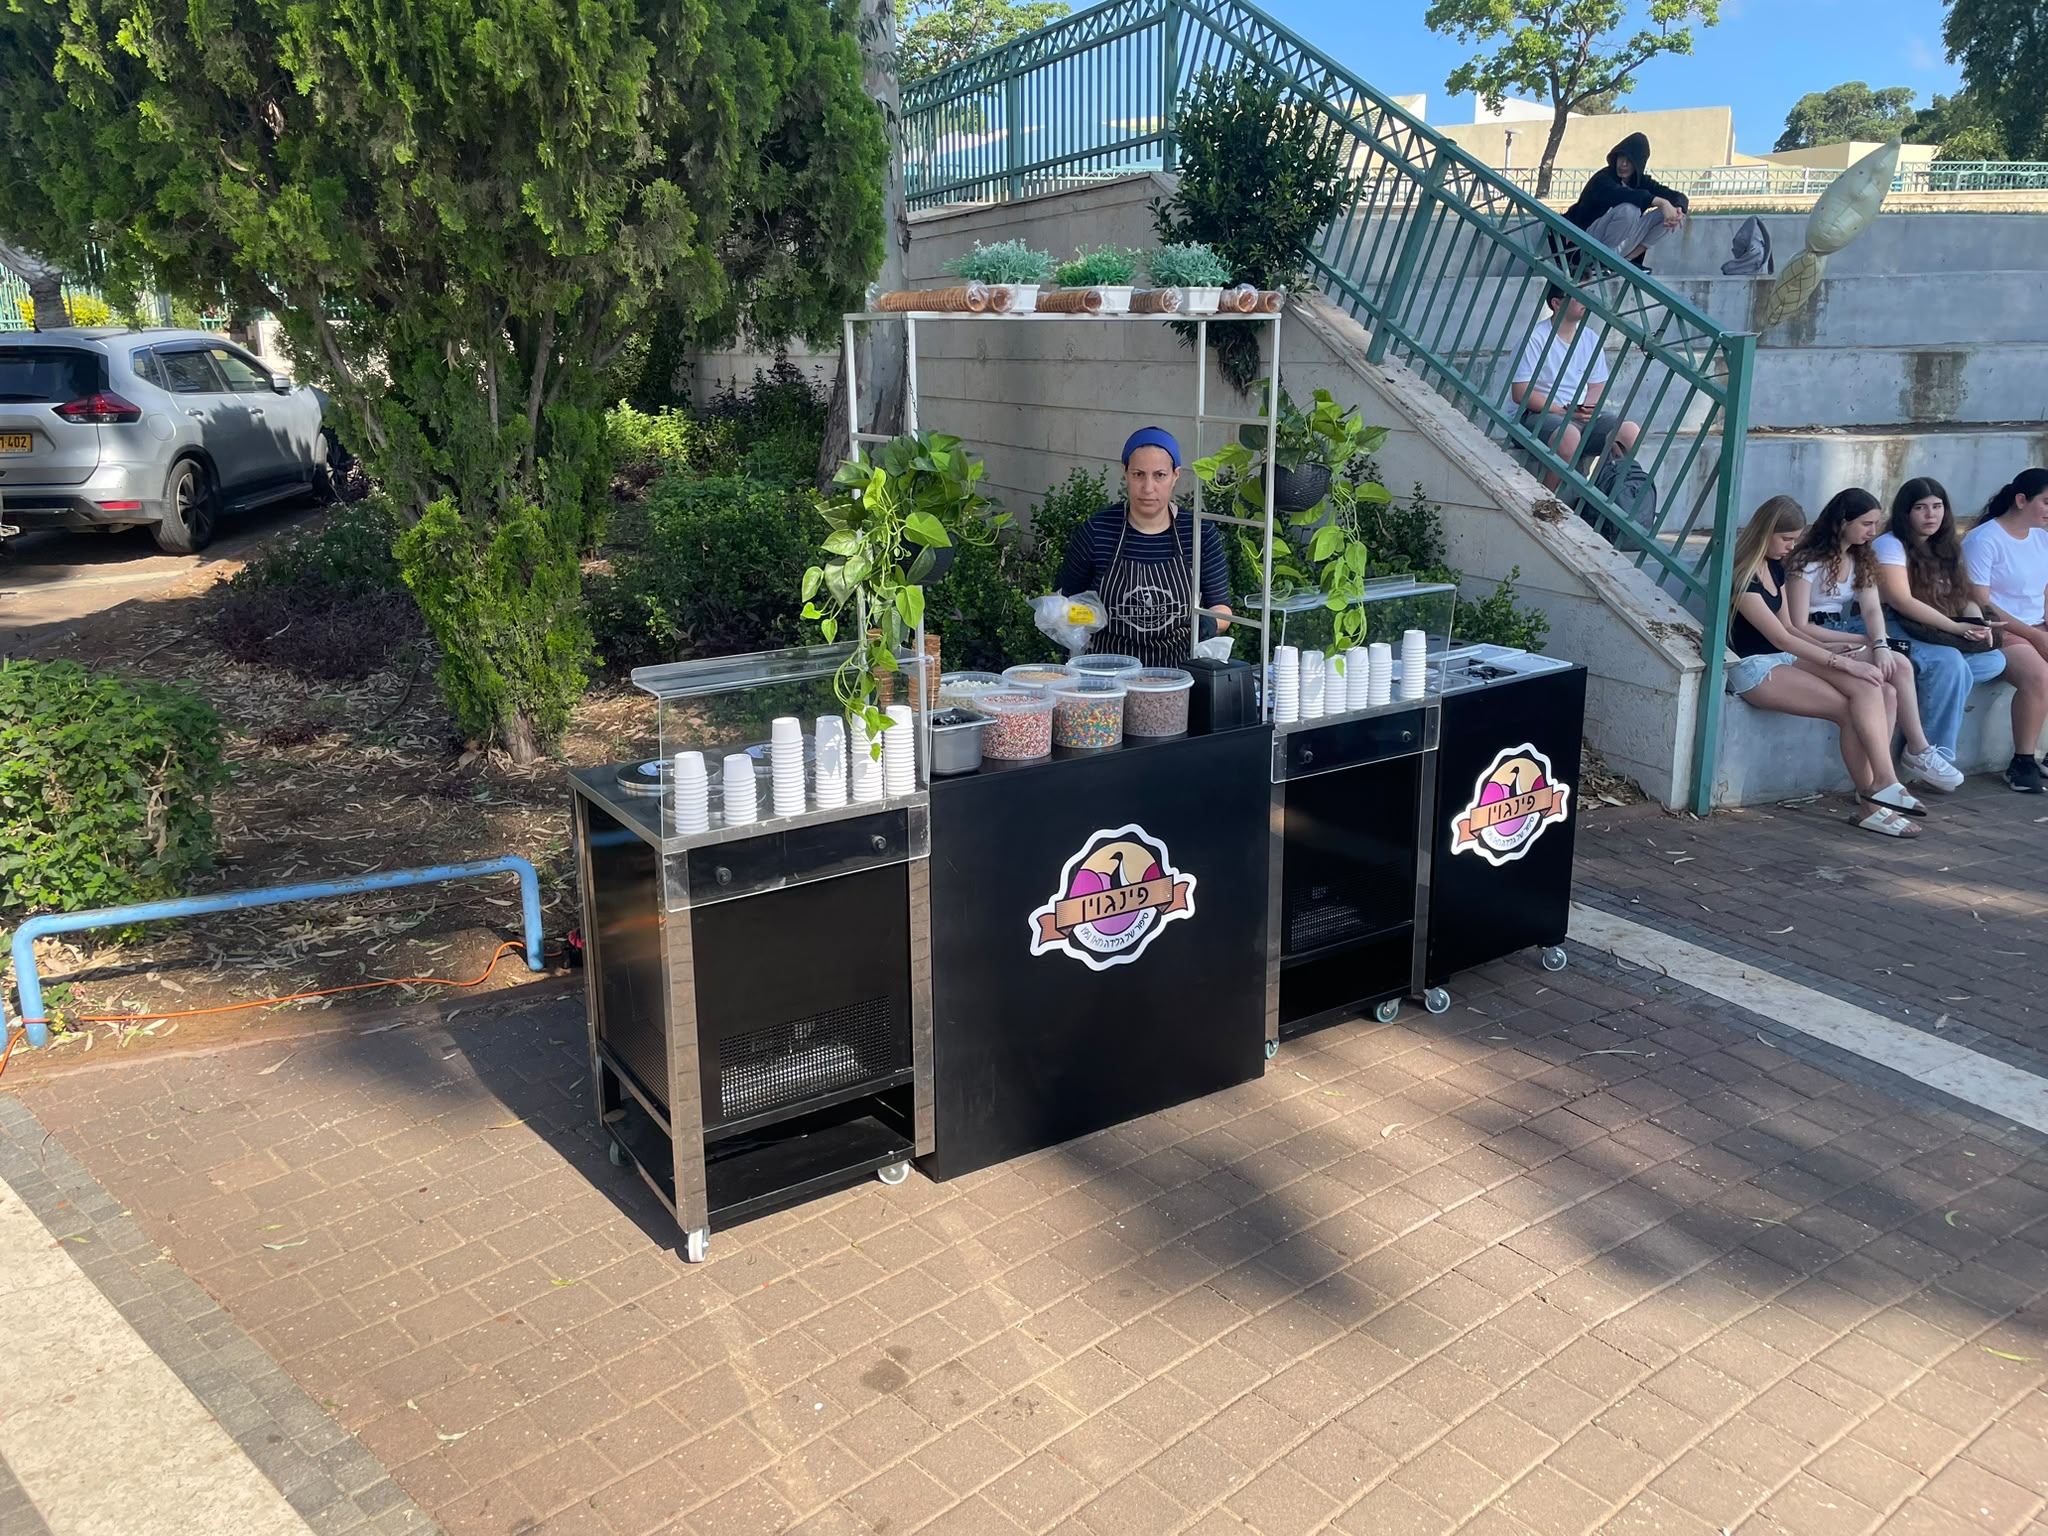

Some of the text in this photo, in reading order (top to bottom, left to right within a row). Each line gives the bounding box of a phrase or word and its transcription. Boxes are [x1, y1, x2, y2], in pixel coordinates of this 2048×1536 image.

[1488, 795, 1535, 825] פינגוין
[1082, 886, 1149, 922] פינגוין
[1135, 912, 1149, 930] סיפור
[1103, 937, 1126, 948] גלידה
[1124, 929, 1135, 941] של
